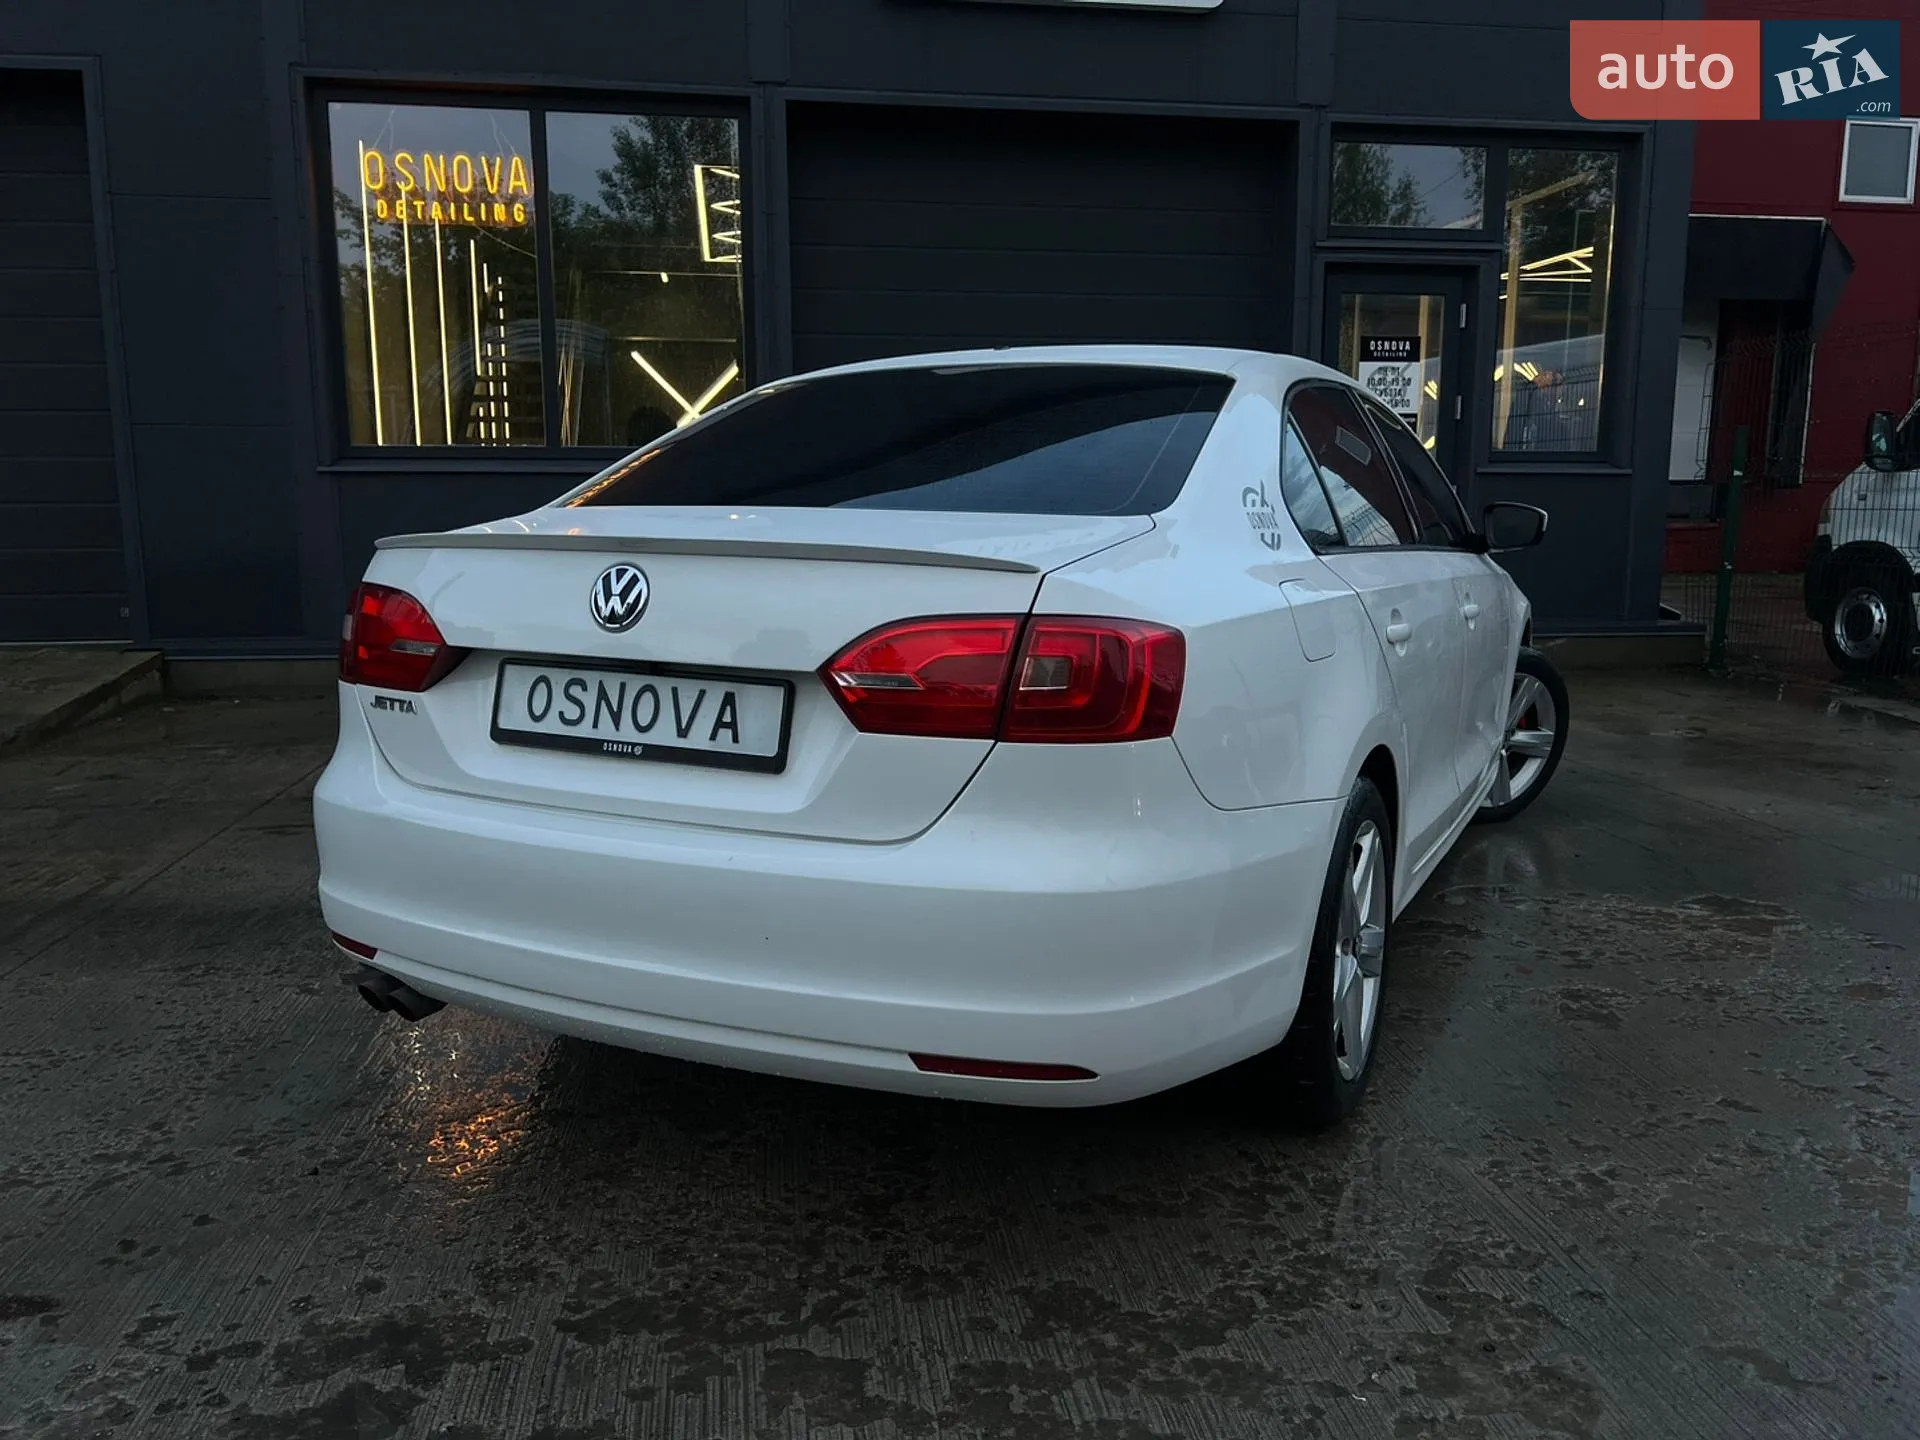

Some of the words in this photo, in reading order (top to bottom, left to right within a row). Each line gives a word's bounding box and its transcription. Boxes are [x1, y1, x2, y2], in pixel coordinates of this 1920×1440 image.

[364, 151, 529, 194] OSNOVA
[377, 199, 527, 222] DETAILING
[1369, 340, 1411, 351] OSNOVA
[370, 695, 418, 715] JETTA
[527, 674, 740, 744] OSNOVA
[602, 741, 632, 753] OSNOVA
